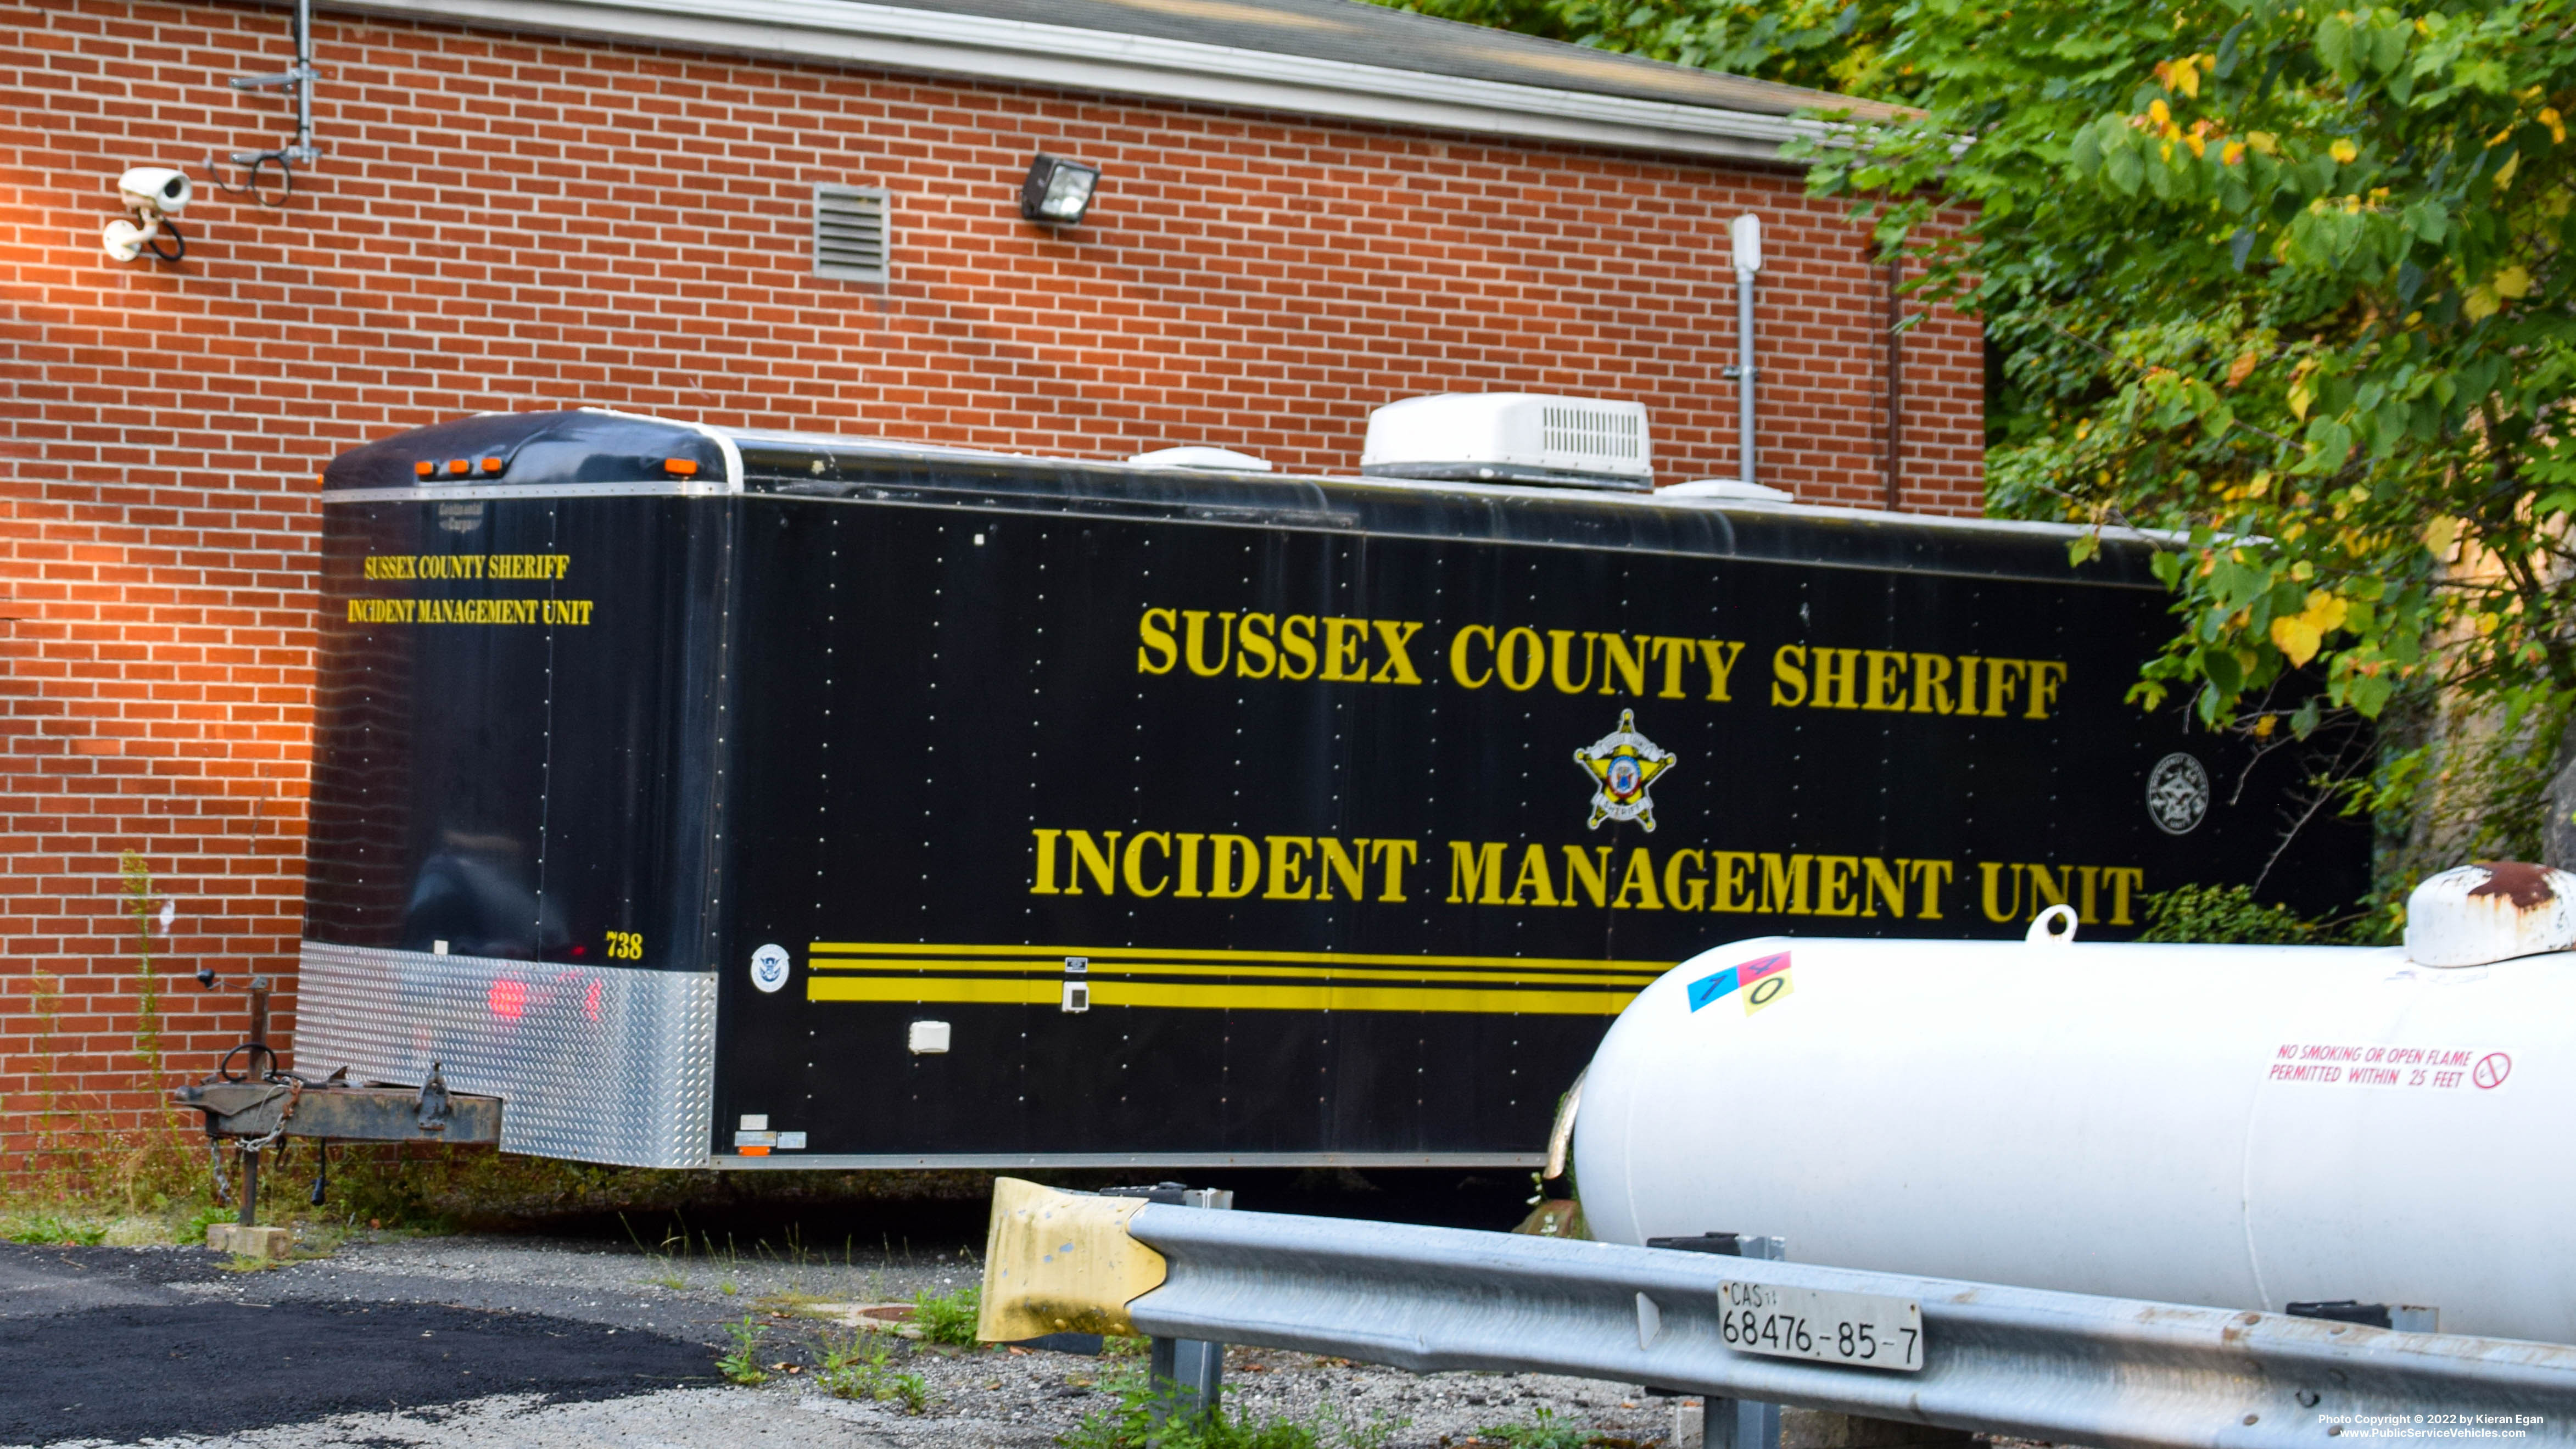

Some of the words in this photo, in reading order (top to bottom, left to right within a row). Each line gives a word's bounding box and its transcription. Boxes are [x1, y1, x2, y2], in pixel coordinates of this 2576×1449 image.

[364, 556, 417, 579] SUSSEX
[418, 555, 485, 578] COUNTY
[488, 555, 570, 579] SHERIFF
[348, 600, 415, 623] INCIDENT
[417, 600, 539, 623] MANAGEMENT
[541, 601, 593, 625] UNIT
[1138, 608, 1424, 685] SUSSEX
[1450, 624, 1746, 702] COUNTY
[1772, 644, 2067, 719] SHERIFF
[1030, 829, 1417, 902] INCIDENT
[1446, 840, 1953, 919] MANAGEMENT
[1977, 861, 2144, 925] UNIT
[606, 930, 643, 960] 738
[1749, 956, 1782, 975] 4
[2277, 1044, 2299, 1059] NO
[2299, 1045, 2363, 1061] SMOKING
[2365, 1047, 2386, 1062] OR
[2388, 1048, 2426, 1064] OPEN
[2426, 1050, 2473, 1066] FLAME
[2268, 1064, 2342, 1082] PERMITTED
[2349, 1067, 2401, 1085] WITHIN
[2408, 1069, 2428, 1086] 25
[2432, 1071, 2465, 1088] FEET
[1723, 1310, 1918, 1364] 68476-85-7
